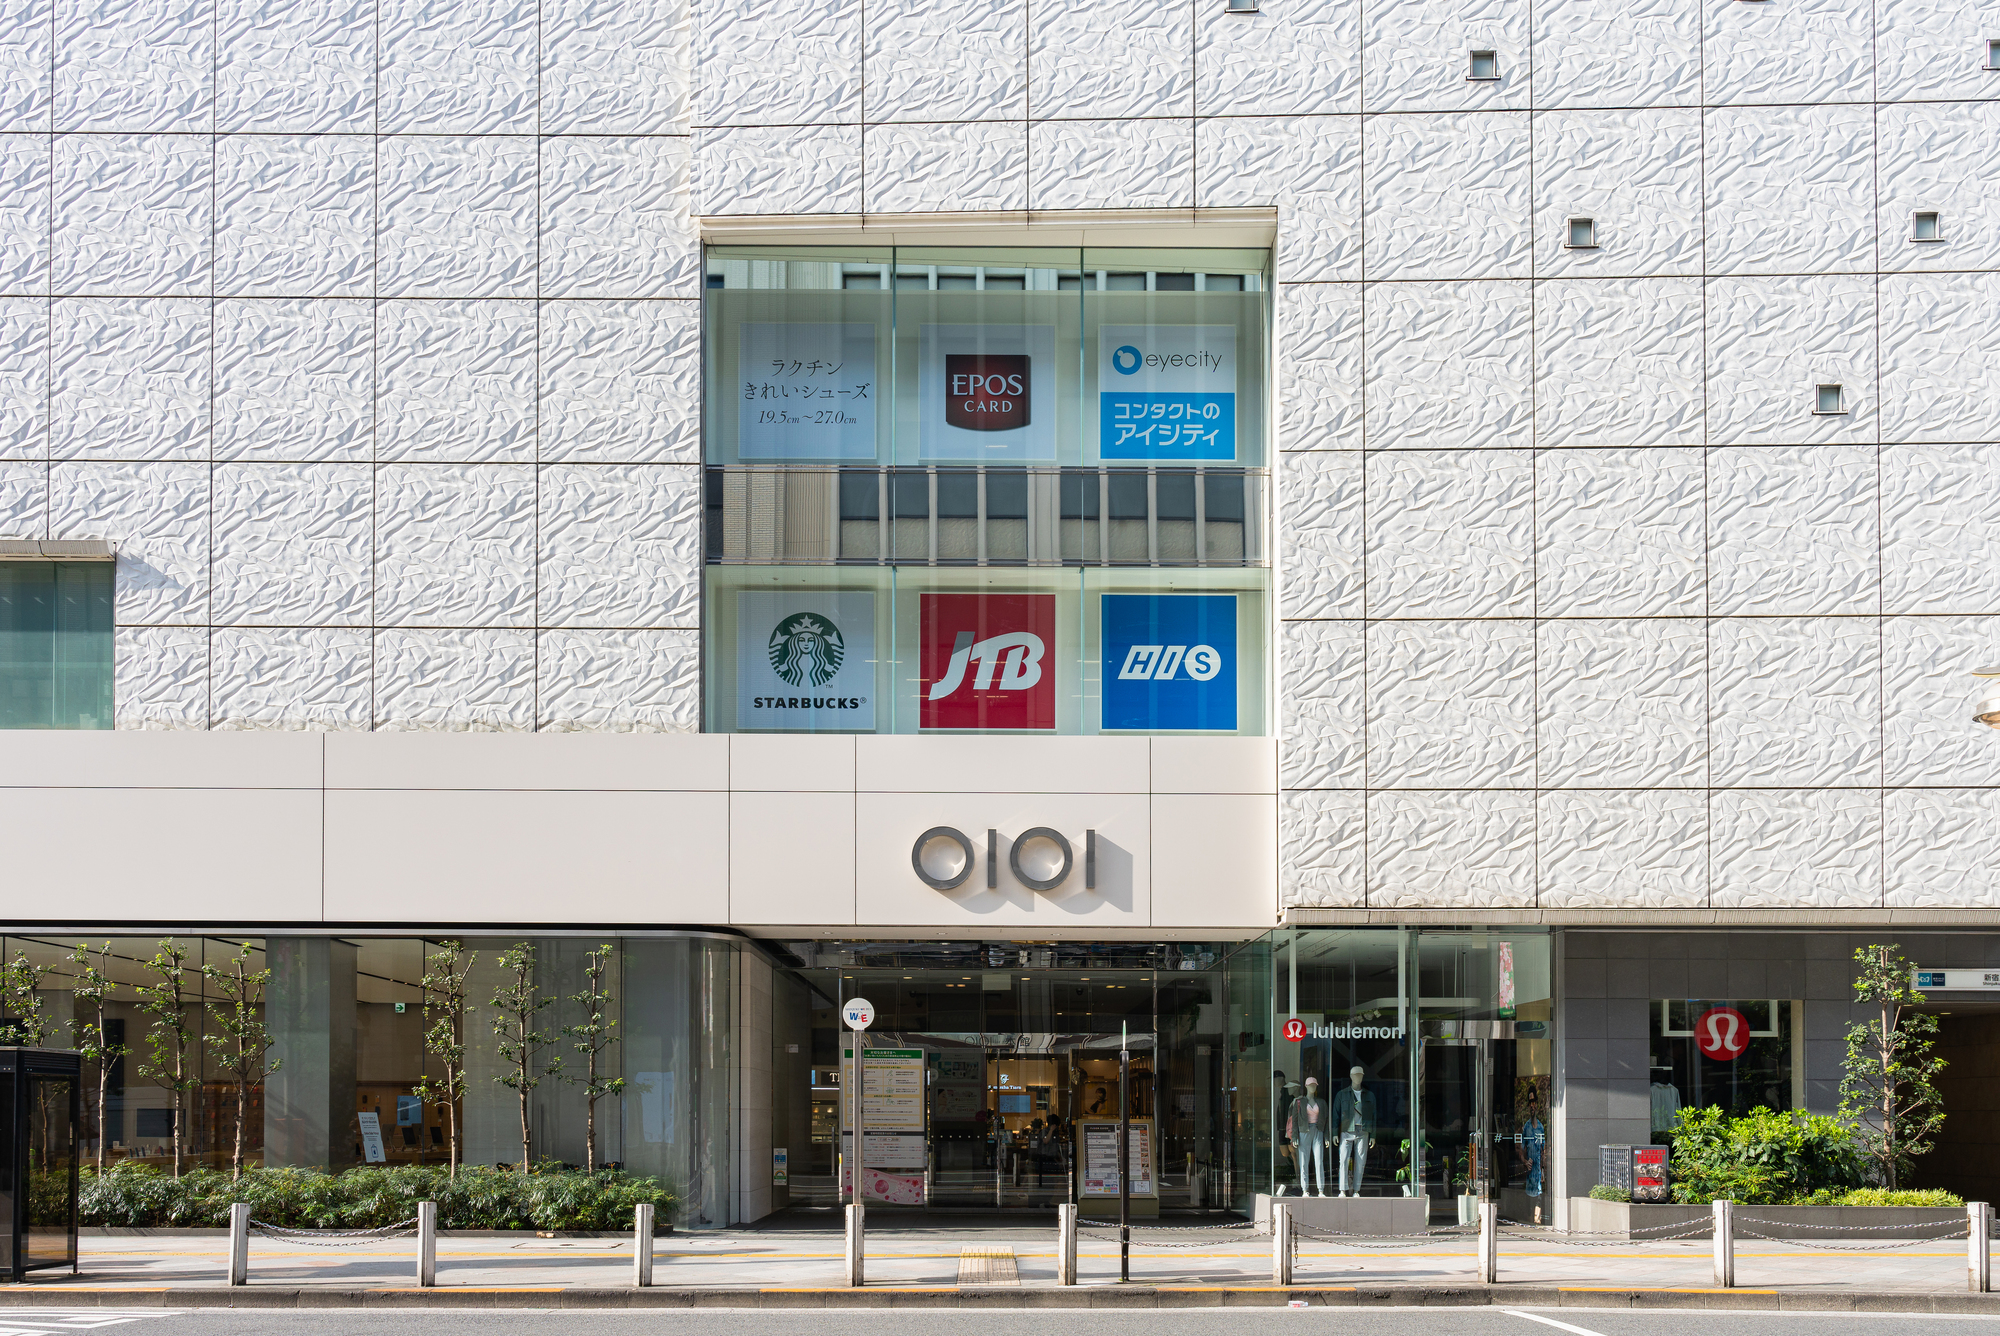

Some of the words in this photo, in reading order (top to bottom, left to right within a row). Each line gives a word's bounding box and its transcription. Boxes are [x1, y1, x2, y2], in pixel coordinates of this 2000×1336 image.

[771, 359, 844, 377] ラクチン
[1145, 350, 1222, 373] eyecity
[744, 381, 871, 400] きれいシューズ
[952, 374, 1024, 396] EPOS
[964, 400, 1013, 413] CARD
[1114, 402, 1221, 420] コンタクトの
[1114, 423, 1220, 446] アイシティ
[928, 631, 1045, 701] JTB
[1117, 644, 1222, 682] HIS
[1312, 1022, 1404, 1040] lululemon
[1494, 1133, 1545, 1144] #一日一汗
